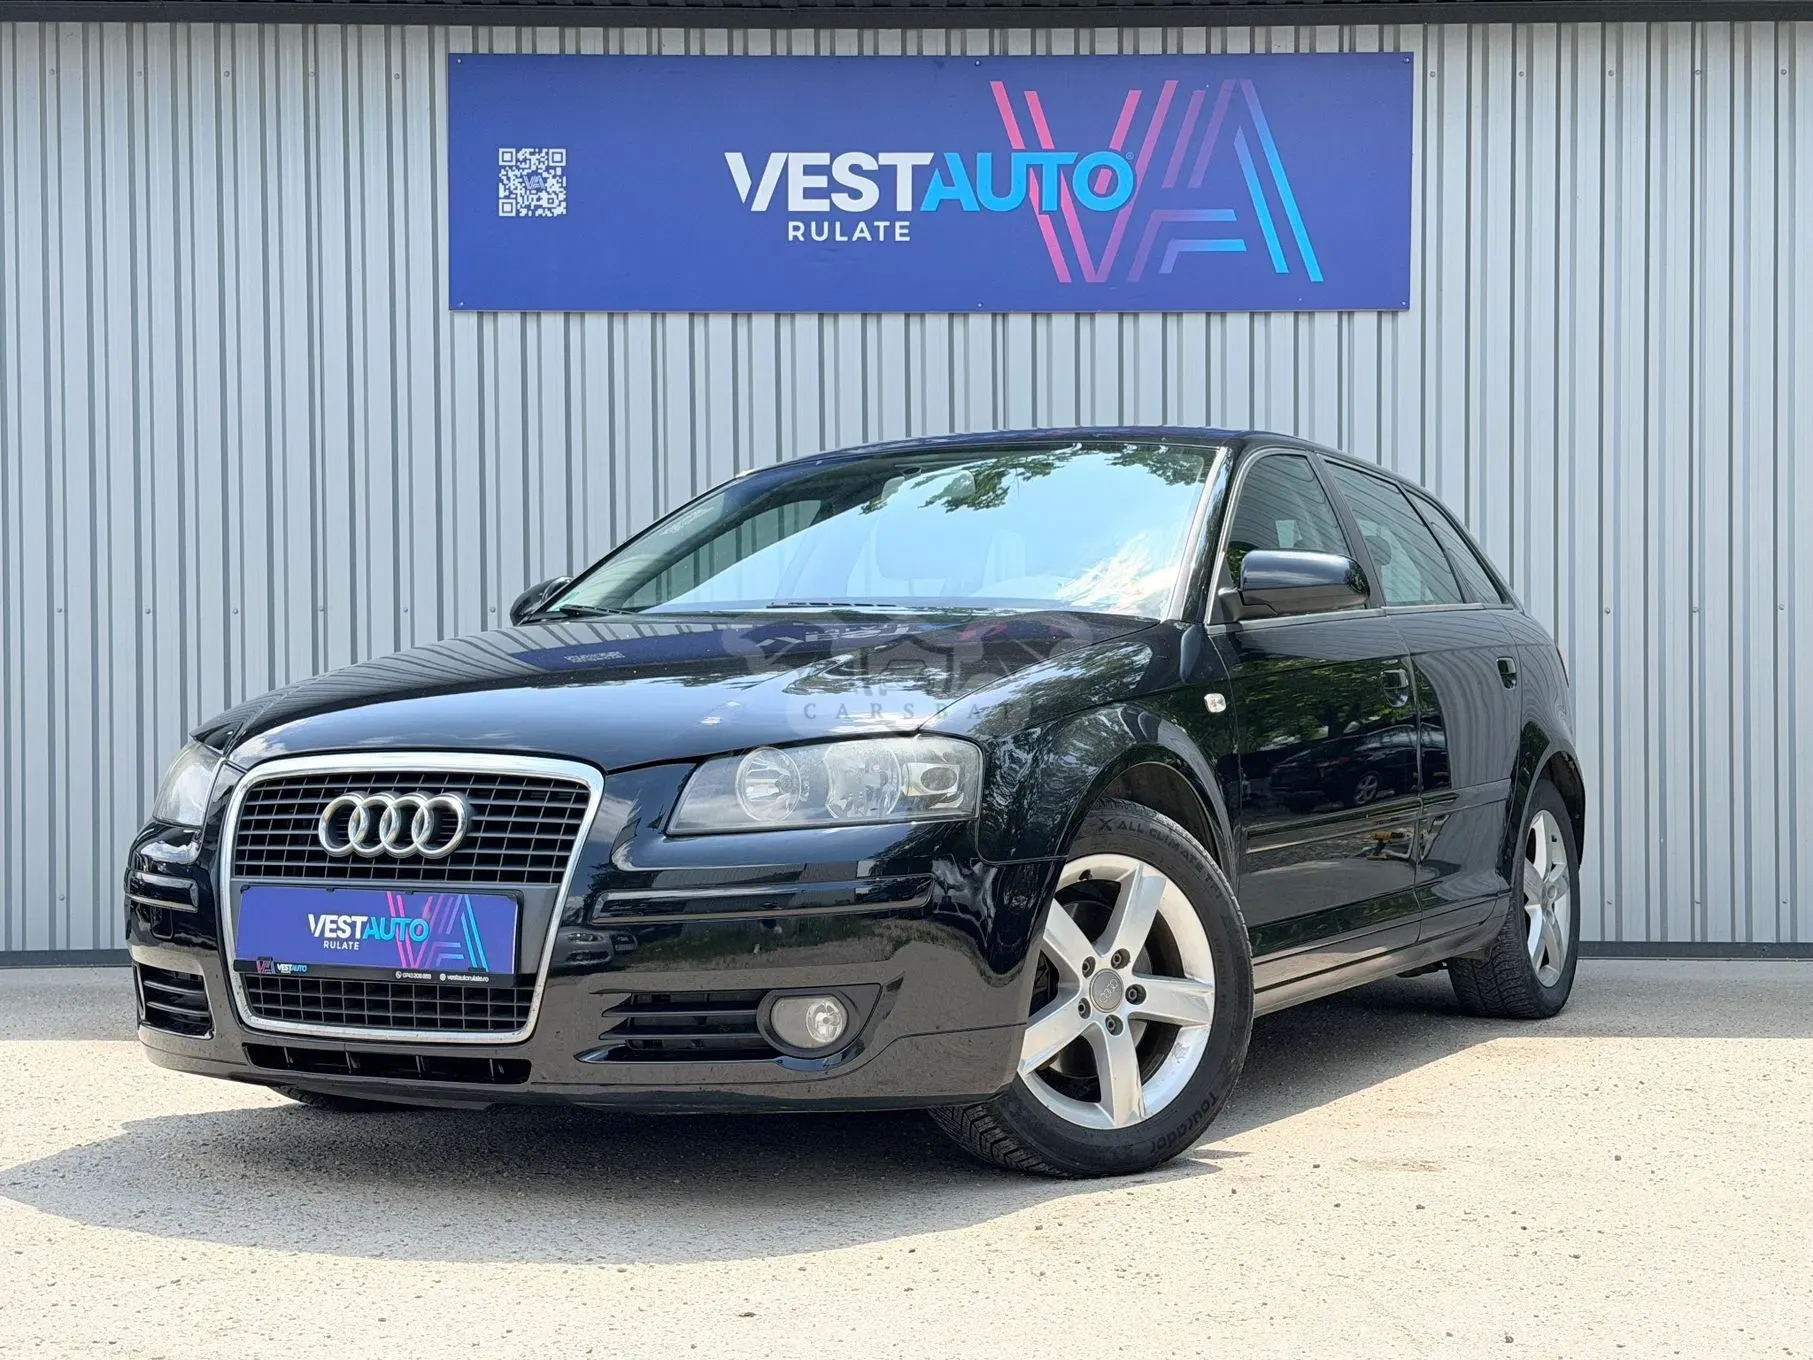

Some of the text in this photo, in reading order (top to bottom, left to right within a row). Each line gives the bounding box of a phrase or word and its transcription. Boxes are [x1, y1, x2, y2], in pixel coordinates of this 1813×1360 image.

[787, 220, 911, 242] RULATE
[1117, 820, 1145, 838] ALL
[1148, 828, 1206, 872] CLIMATE
[307, 913, 430, 942] VESTAUTO
[323, 939, 361, 951] RULATE
[276, 963, 308, 973] VESTAUTO
[1150, 1091, 1220, 1154] Tourador
